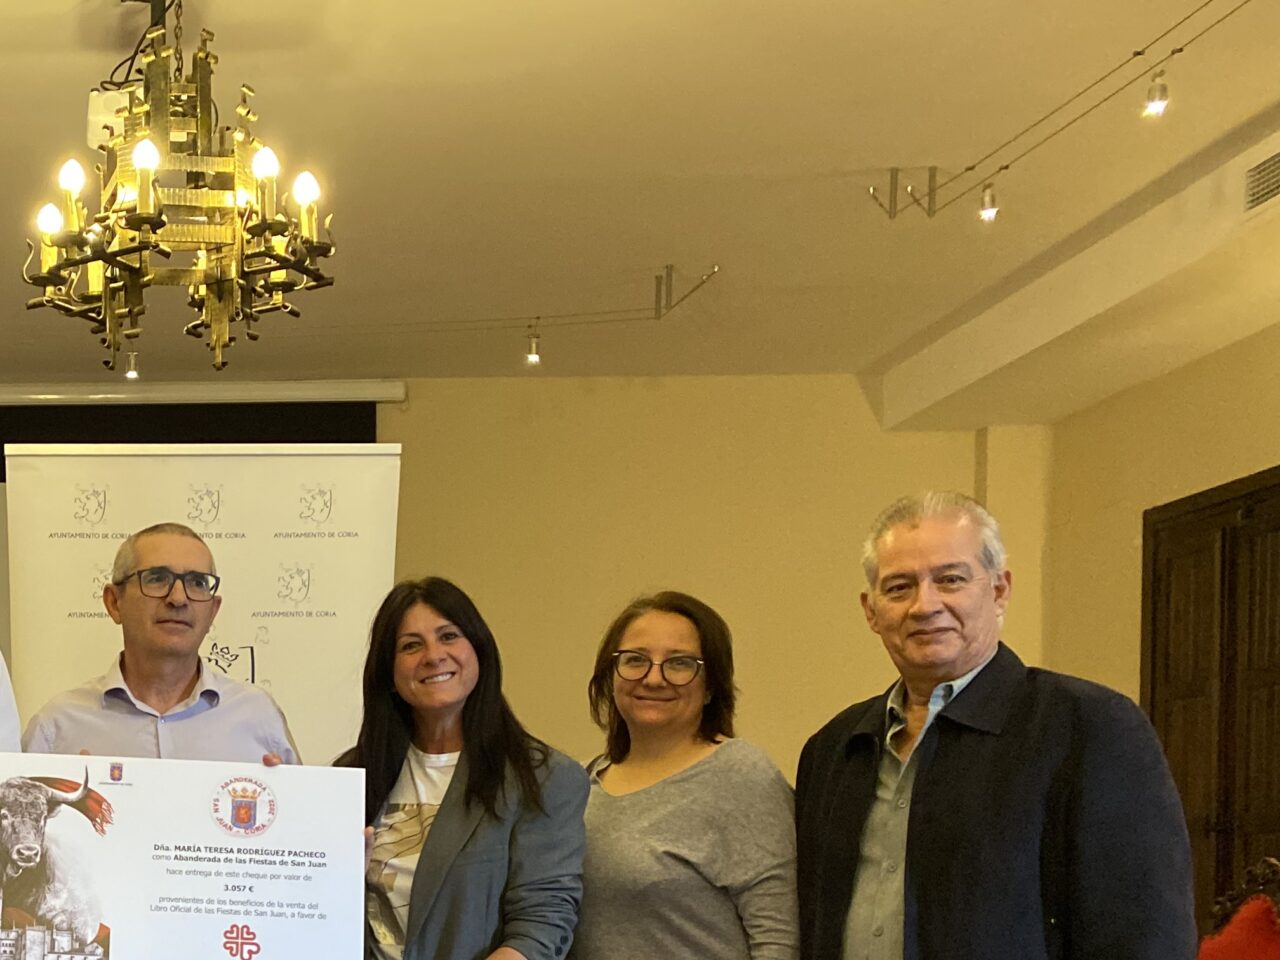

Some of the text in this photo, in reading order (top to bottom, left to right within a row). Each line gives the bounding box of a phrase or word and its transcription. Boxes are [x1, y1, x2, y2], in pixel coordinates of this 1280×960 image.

[48, 532, 100, 540] AYUNTAMIENTO
[215, 531, 223, 539] DE
[225, 531, 246, 539] CORIA
[273, 531, 326, 539] AYUNTAMIENTO
[67, 611, 110, 619] AYUNTAMIEN
[315, 610, 337, 618] CORIA
[216, 816, 233, 832] JUAN
[174, 844, 201, 853] MARÍA
[204, 846, 234, 854] TERESA
[287, 850, 326, 859] PACHECO
[173, 854, 221, 863] Abanderada
[248, 857, 277, 866] Fiestas
[279, 859, 289, 867] de
[308, 860, 327, 868] Juan
[166, 867, 183, 875] hace
[185, 869, 212, 878] entrega
[214, 870, 223, 878] de
[242, 871, 268, 880] cheque
[269, 873, 281, 881] por
[303, 874, 313, 882] de
[223, 884, 254, 893] 3.057 €
[158, 896, 204, 904] provenientes
[266, 900, 276, 908] de
[277, 900, 284, 908] la
[307, 902, 319, 910] del
[150, 904, 168, 912] Libro
[169, 905, 192, 913] Oficial
[193, 906, 203, 914] de
[216, 907, 242, 916] Fiestas
[243, 908, 252, 916] de
[254, 909, 268, 917] San
[297, 911, 315, 919] favor
[317, 912, 327, 920] de
